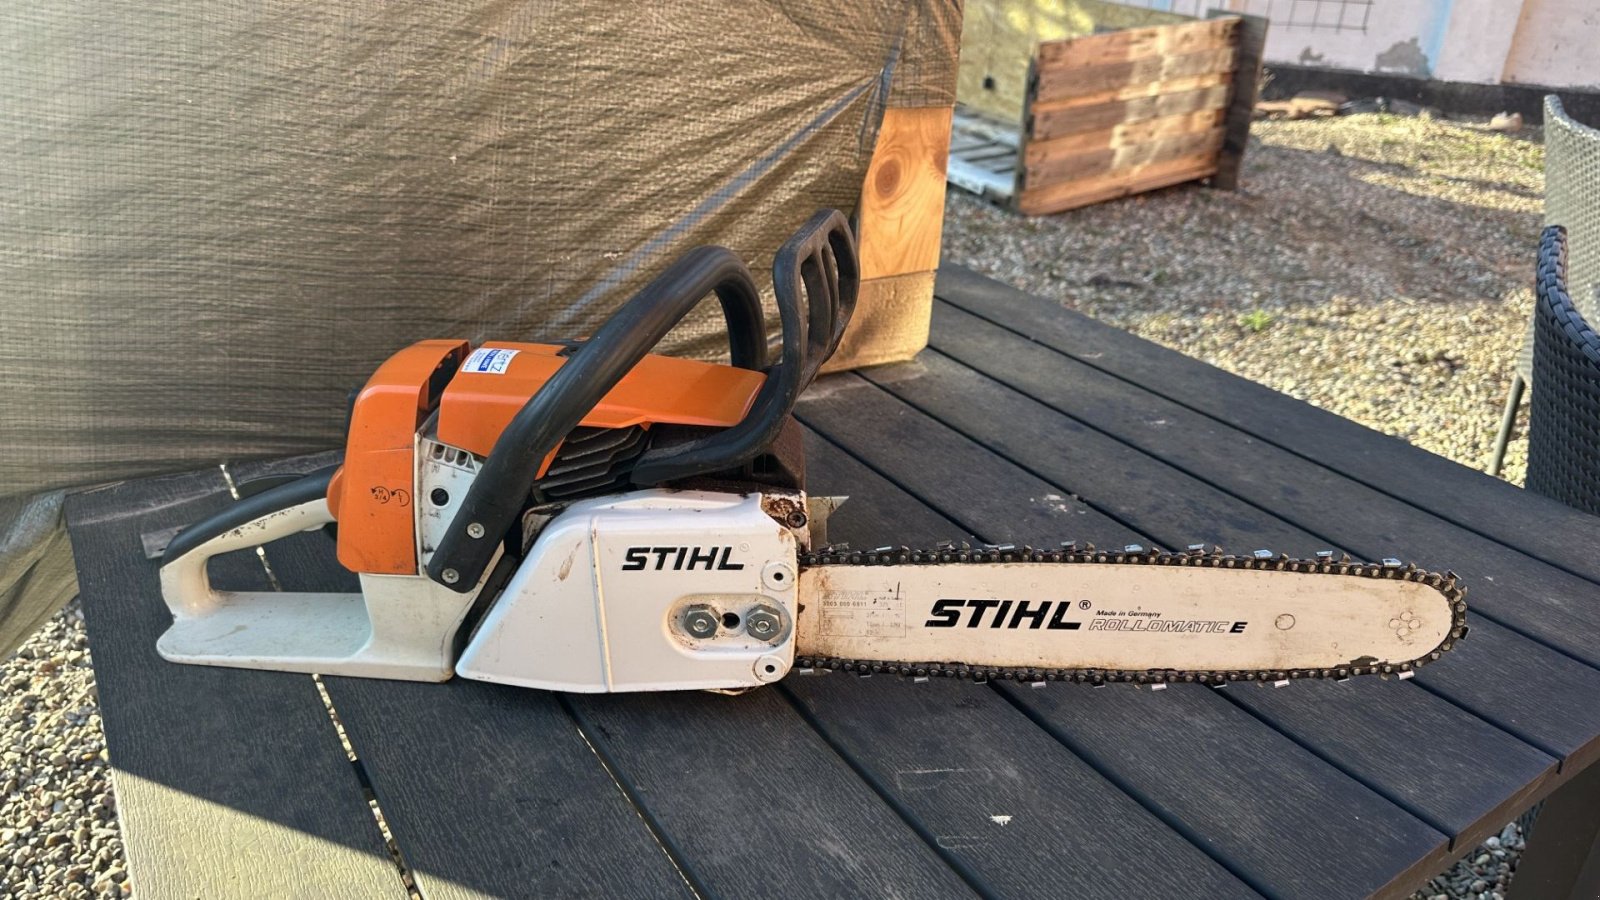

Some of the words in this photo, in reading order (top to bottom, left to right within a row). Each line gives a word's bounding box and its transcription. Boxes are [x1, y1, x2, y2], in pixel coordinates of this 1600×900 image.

[621, 546, 745, 571] STIHL
[924, 599, 1082, 631] STIHL
[1127, 610, 1162, 618] Germany
[1088, 618, 1230, 634] ROLLOMATIC
[1229, 621, 1248, 634] E
